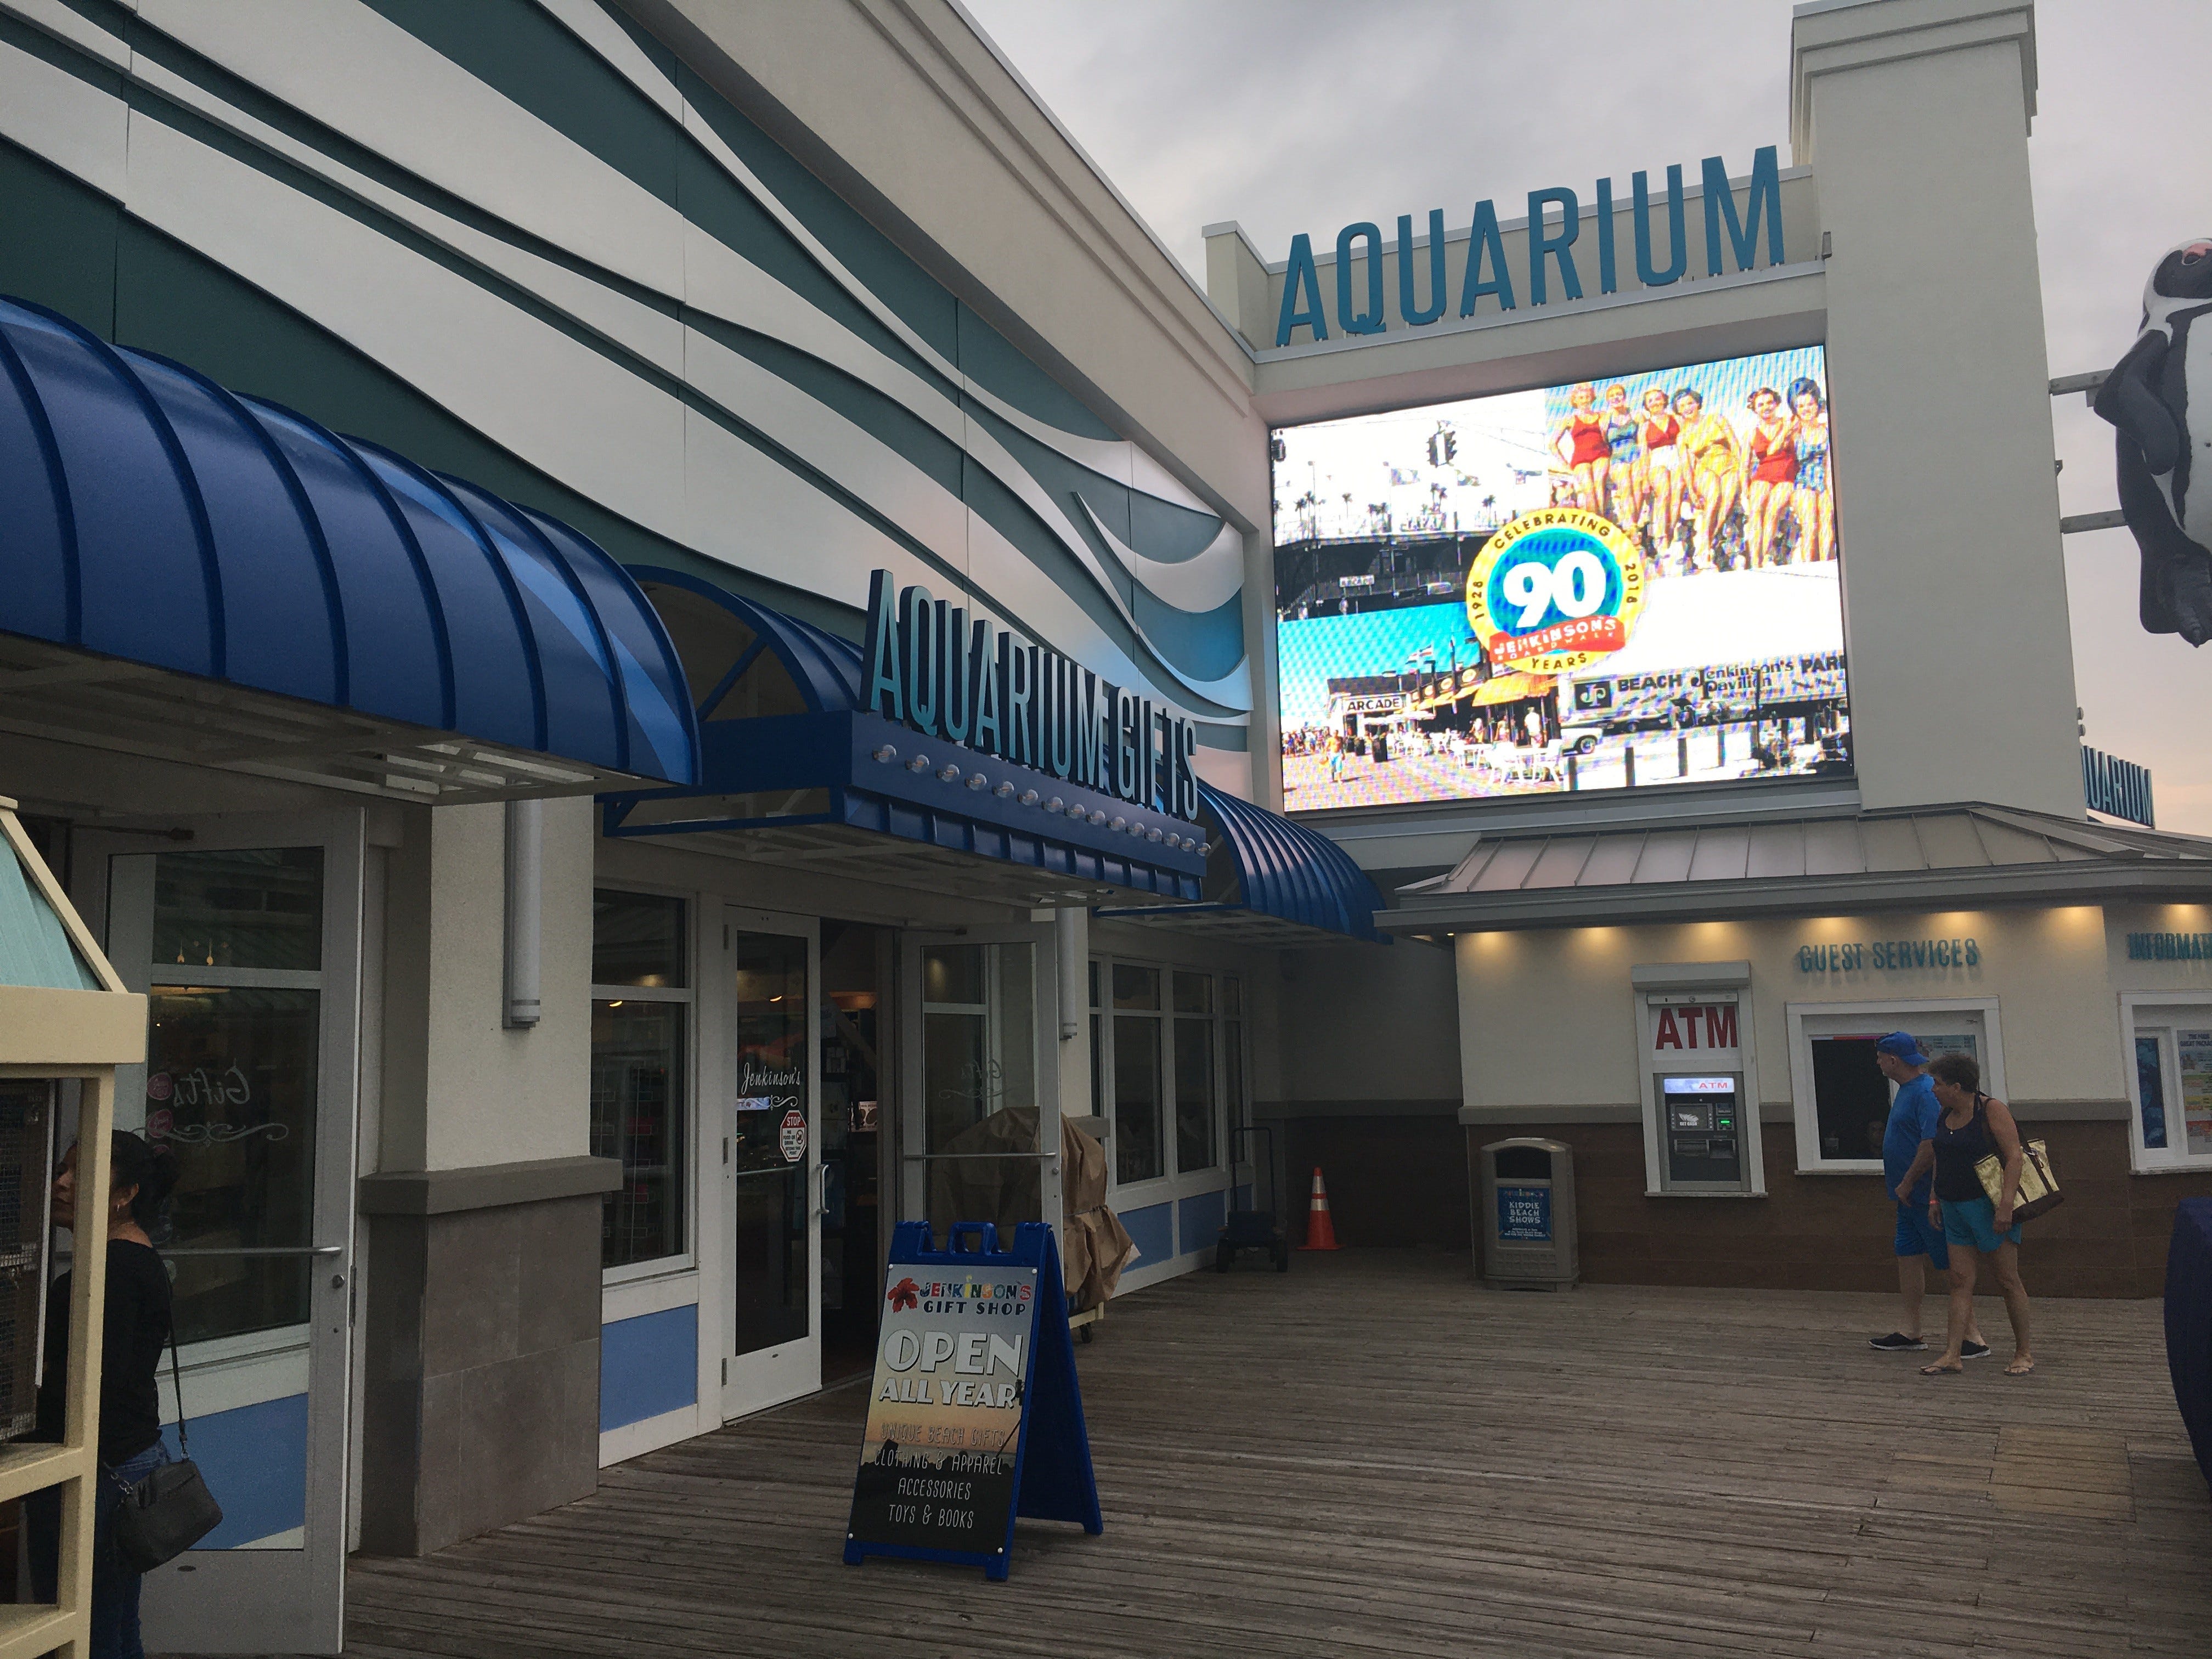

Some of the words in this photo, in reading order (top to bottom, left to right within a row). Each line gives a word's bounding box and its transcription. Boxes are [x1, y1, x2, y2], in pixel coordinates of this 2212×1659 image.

[1276, 145, 1784, 347] AQUARIUM
[1494, 514, 1610, 549] CELEBRATING
[1471, 581, 1484, 619] 1928
[1503, 550, 1606, 628] 90
[1532, 653, 1587, 669] YEARS
[860, 569, 1104, 789] AQUARIUM
[1108, 686, 1198, 820] GIFTS
[1618, 674, 1681, 691] BEACH
[1347, 697, 1401, 712] ARCADE
[1800, 943, 1863, 972] GUEST
[1872, 938, 1978, 969] SERVICES
[1655, 1006, 1738, 1050] ATM
[741, 1062, 800, 1095] Jenkinson's
[787, 1116, 801, 1126] STOP
[923, 1301, 967, 1314] GIFT
[976, 1302, 1026, 1316] SHOP
[884, 1329, 1023, 1378] OPEN
[879, 1378, 933, 1404] ALL
[940, 1379, 1016, 1409] YEAR
[881, 1422, 922, 1442] UNIQUE
[928, 1426, 965, 1445] BEACH
[971, 1428, 1006, 1447] GIFTS
[874, 1449, 929, 1470] CLOTHING
[936, 1451, 946, 1470] &
[952, 1454, 1002, 1475] APPAREL
[898, 1477, 971, 1500] ACCESSORIES
[889, 1504, 916, 1523] TOYS
[923, 1504, 932, 1525] &
[938, 1509, 974, 1528] BOOKS
